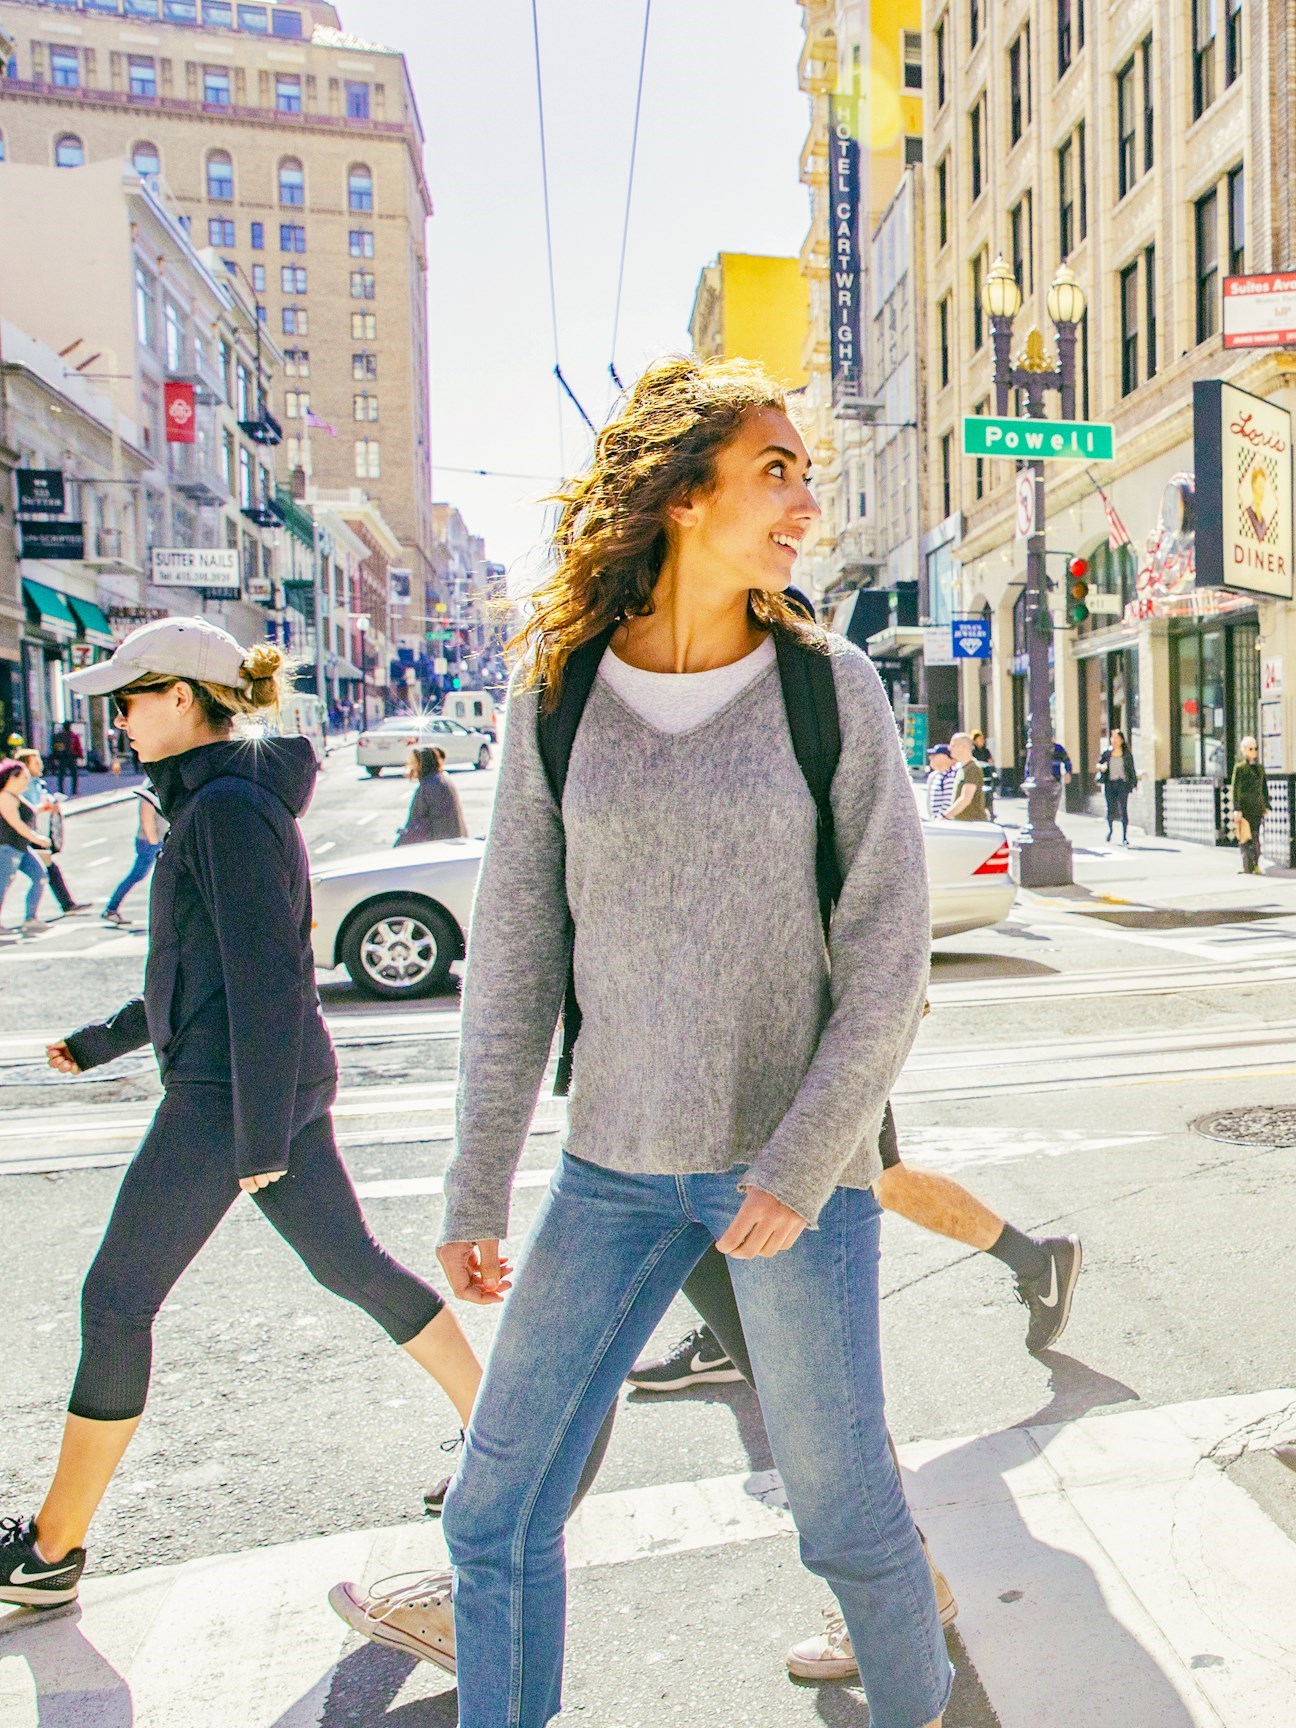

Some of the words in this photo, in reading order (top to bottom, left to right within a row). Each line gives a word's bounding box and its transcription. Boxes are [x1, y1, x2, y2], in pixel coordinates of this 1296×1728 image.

[837, 106, 851, 192] HOTEL
[836, 202, 853, 376] CARTWRIGHT
[1230, 281, 1270, 295] Suites
[985, 426, 1094, 452] Powell
[156, 552, 195, 567] SUTTER
[200, 554, 234, 568] NAILS
[1234, 544, 1286, 576] DINER
[76, 647, 90, 665] 7
